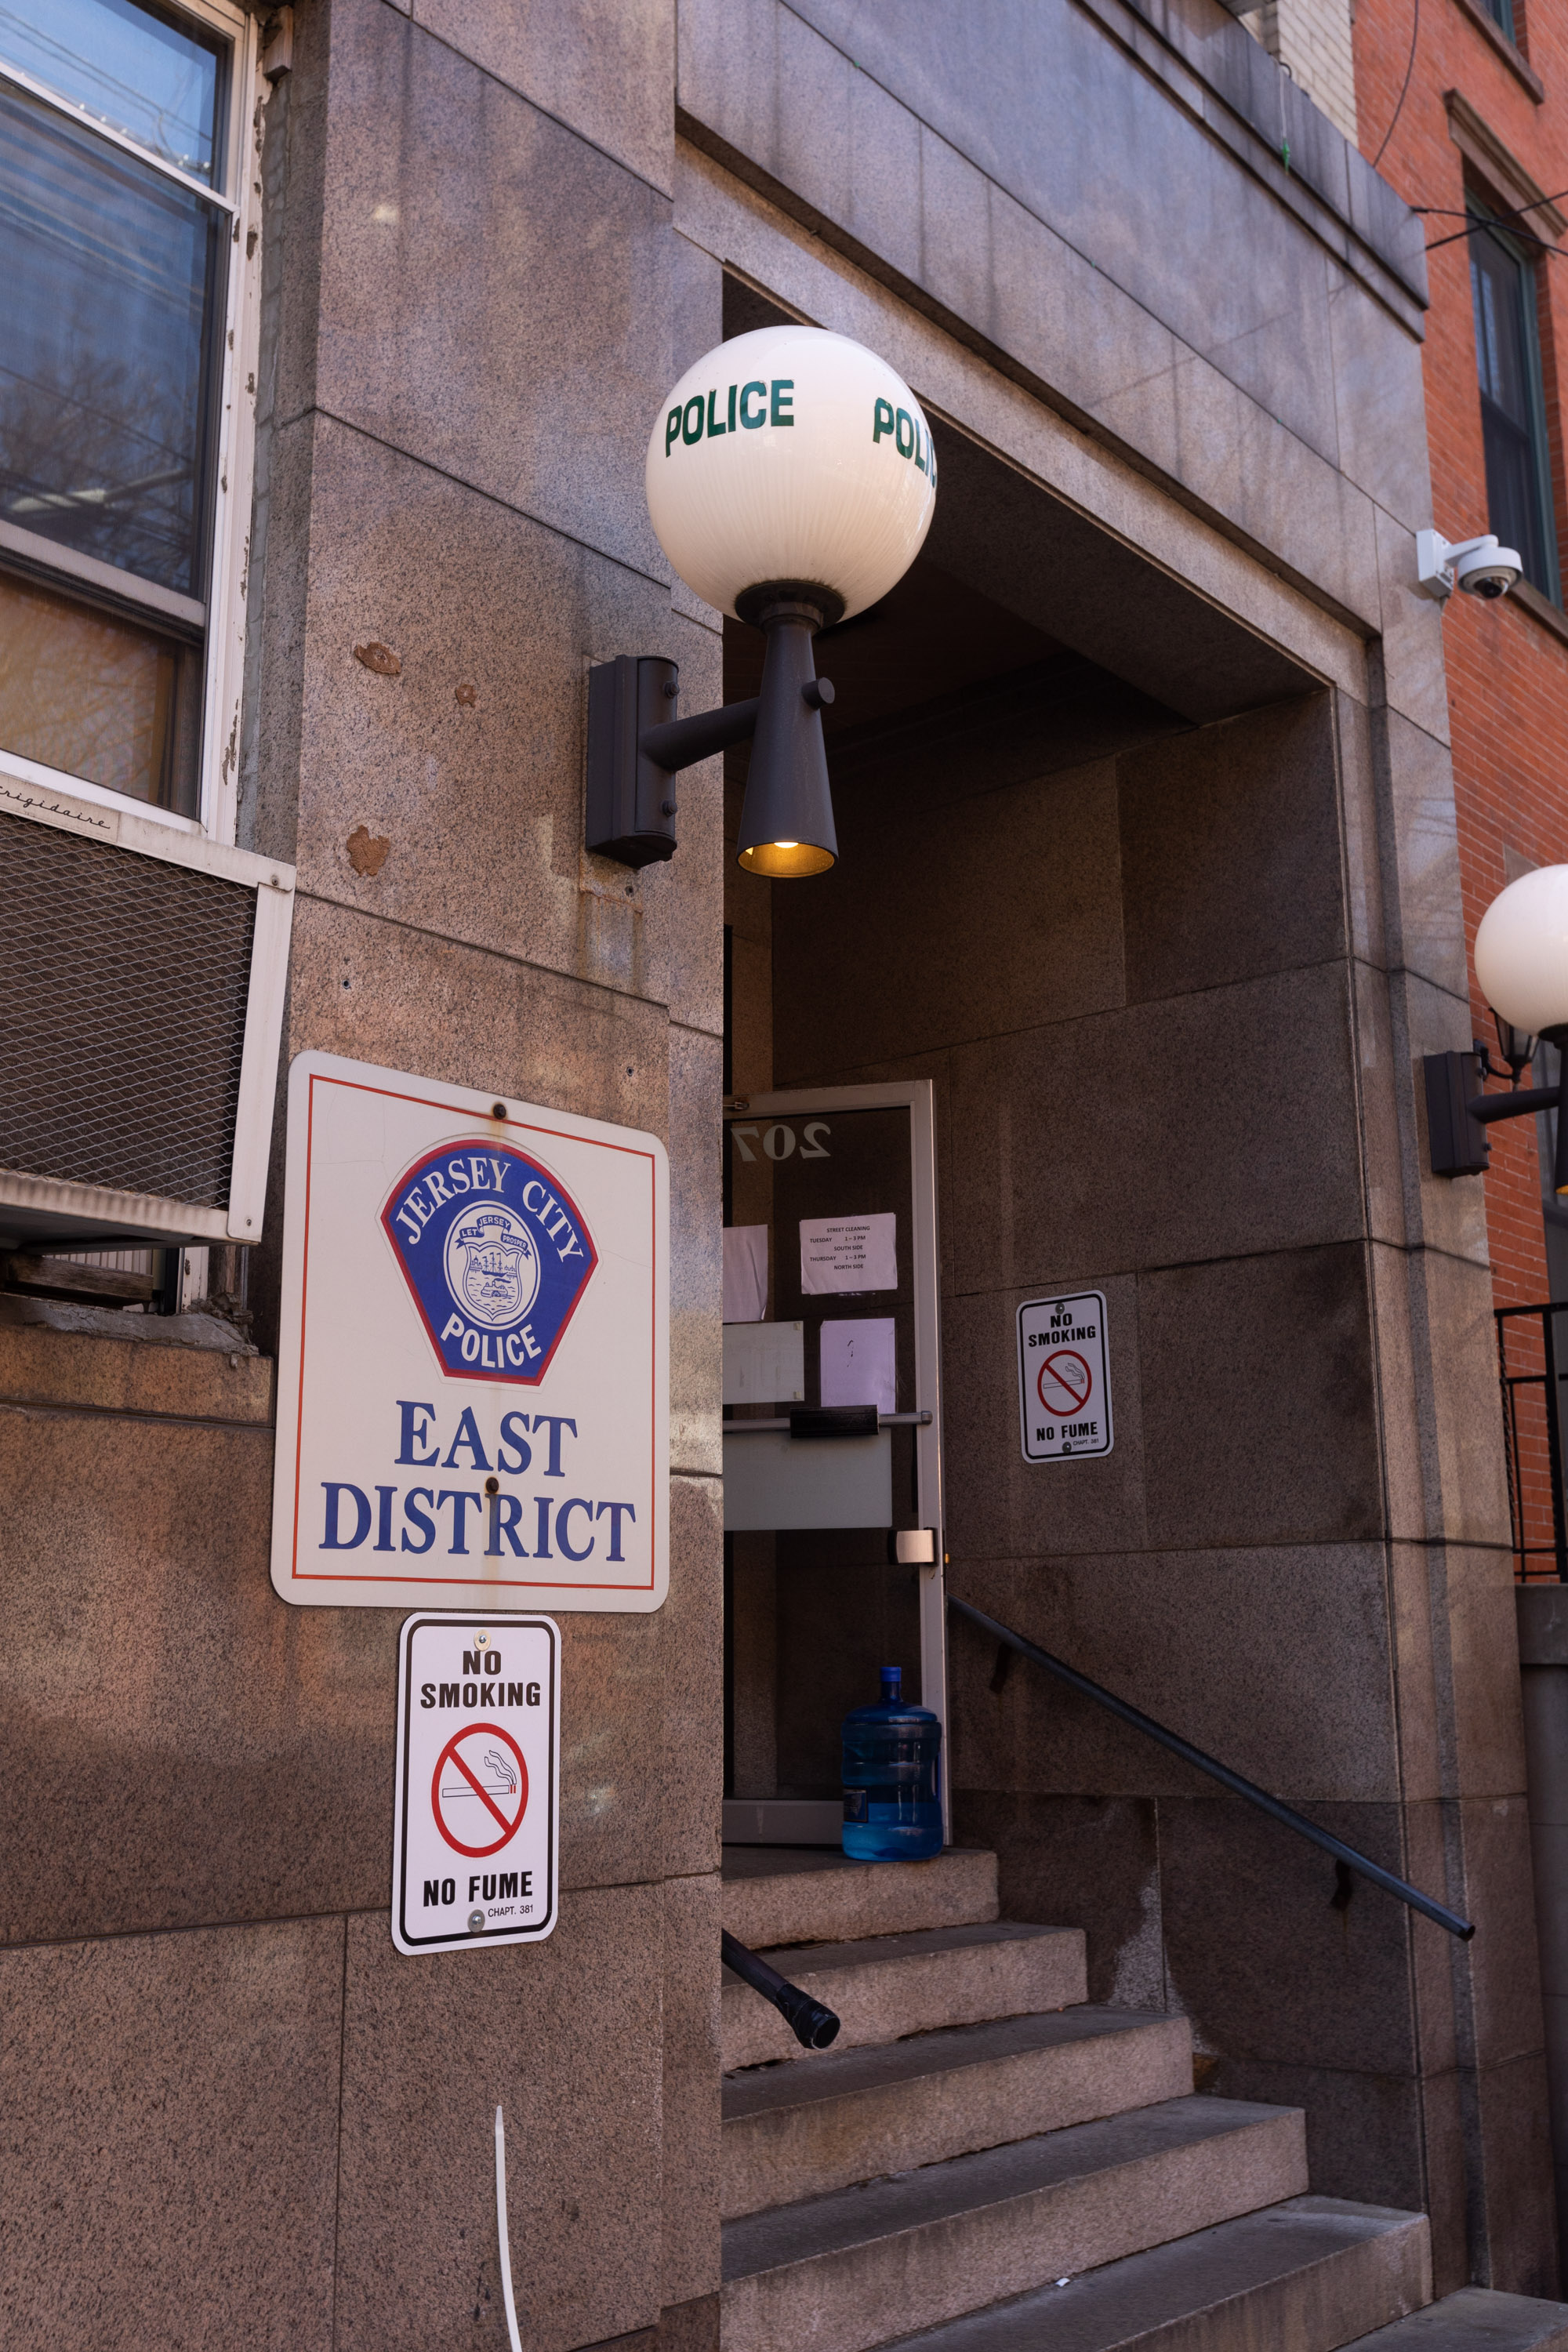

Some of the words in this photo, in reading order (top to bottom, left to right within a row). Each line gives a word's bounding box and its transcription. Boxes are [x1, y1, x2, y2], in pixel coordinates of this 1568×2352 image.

[666, 379, 794, 458] POLICE
[0, 786, 111, 829] rigidaire
[396, 1156, 511, 1245] JERSEY
[522, 1180, 583, 1263] CITY
[478, 1216, 510, 1229] JERSEY
[503, 1235, 527, 1249] PROSPER
[1028, 1325, 1096, 1347] SMOKING
[1050, 1312, 1073, 1328] NO
[440, 1312, 542, 1368] POLICE
[394, 1400, 578, 1477] EAST
[1036, 1426, 1054, 1441] NO
[1061, 1421, 1098, 1439] FUME
[318, 1482, 636, 1562] DISTRICT
[463, 1650, 502, 1675] NO
[420, 1682, 541, 1709] SMOKING
[423, 1878, 456, 1907] NO
[468, 1871, 533, 1902] FUME
[488, 1905, 517, 1918] CHAPT.
[519, 1904, 533, 1915] 381
